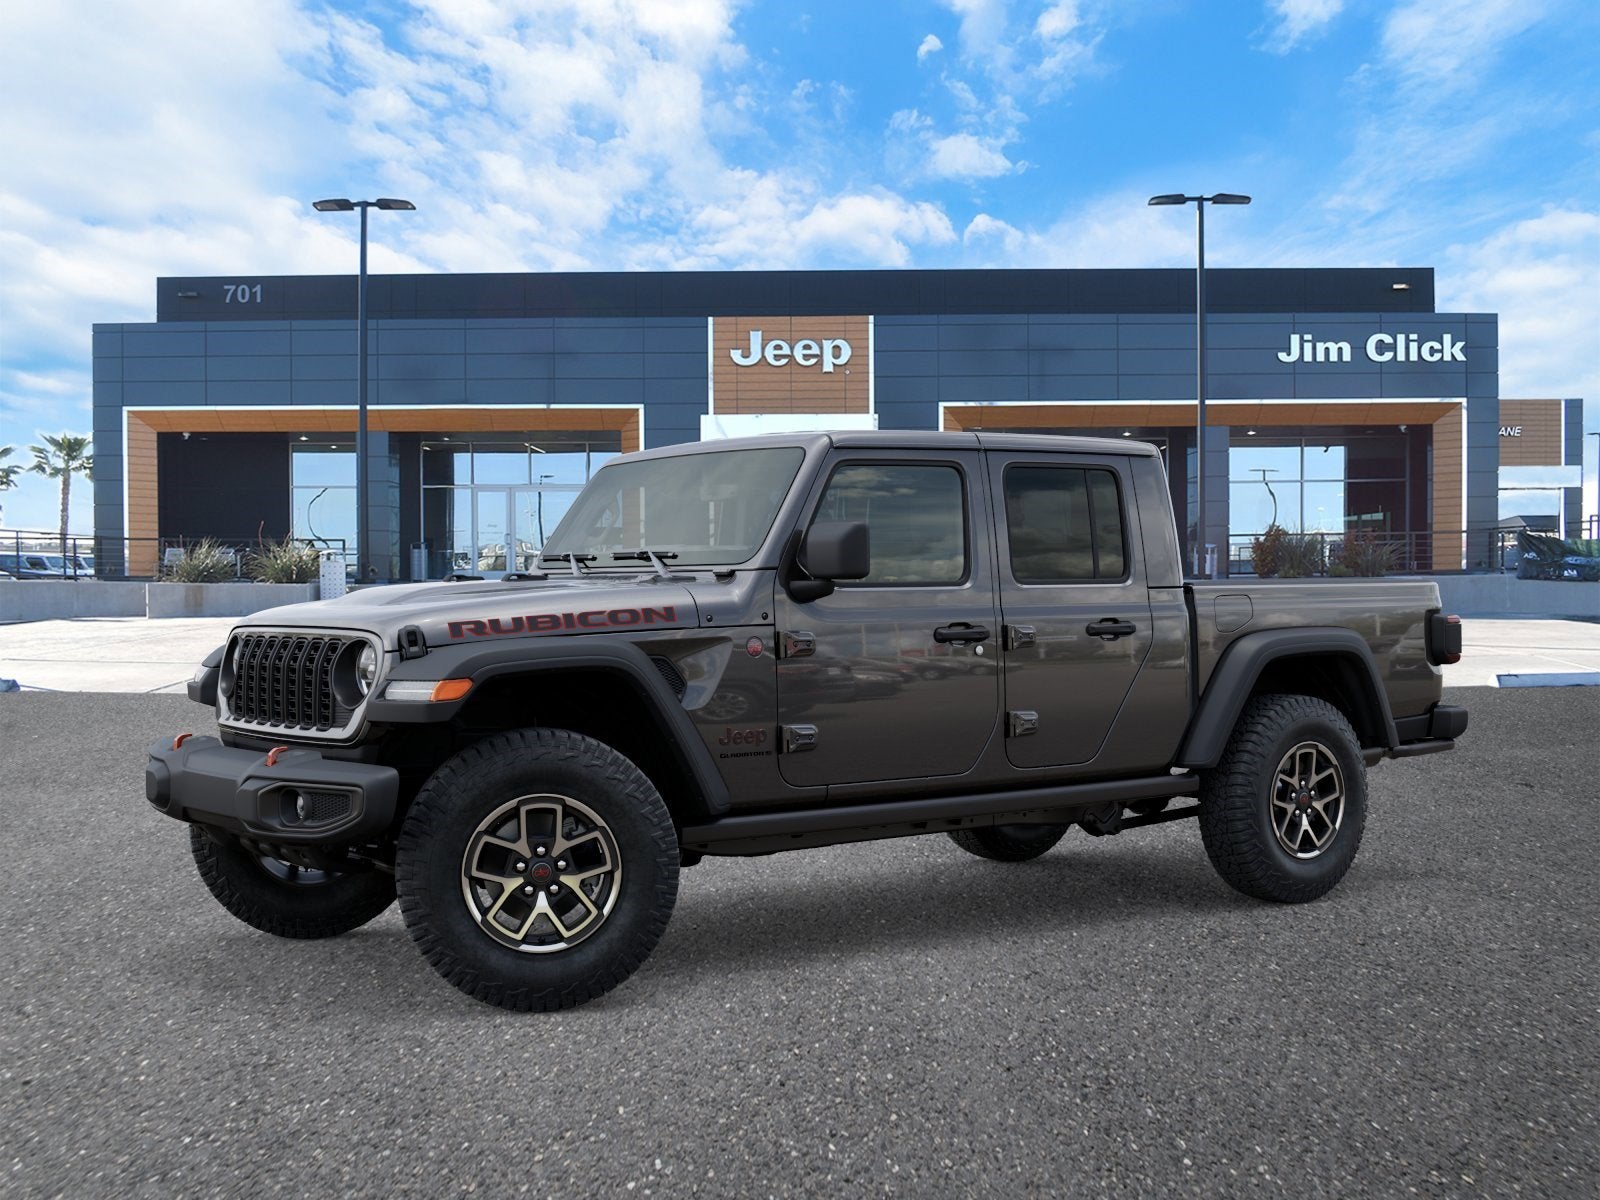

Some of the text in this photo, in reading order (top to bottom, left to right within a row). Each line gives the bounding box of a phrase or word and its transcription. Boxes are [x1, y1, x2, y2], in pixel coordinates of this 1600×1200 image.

[224, 284, 261, 304] 701
[729, 329, 853, 374] Jeep
[1277, 332, 1467, 363] Jim Click
[447, 606, 677, 639] RUBICON
[719, 726, 768, 747] Jeep
